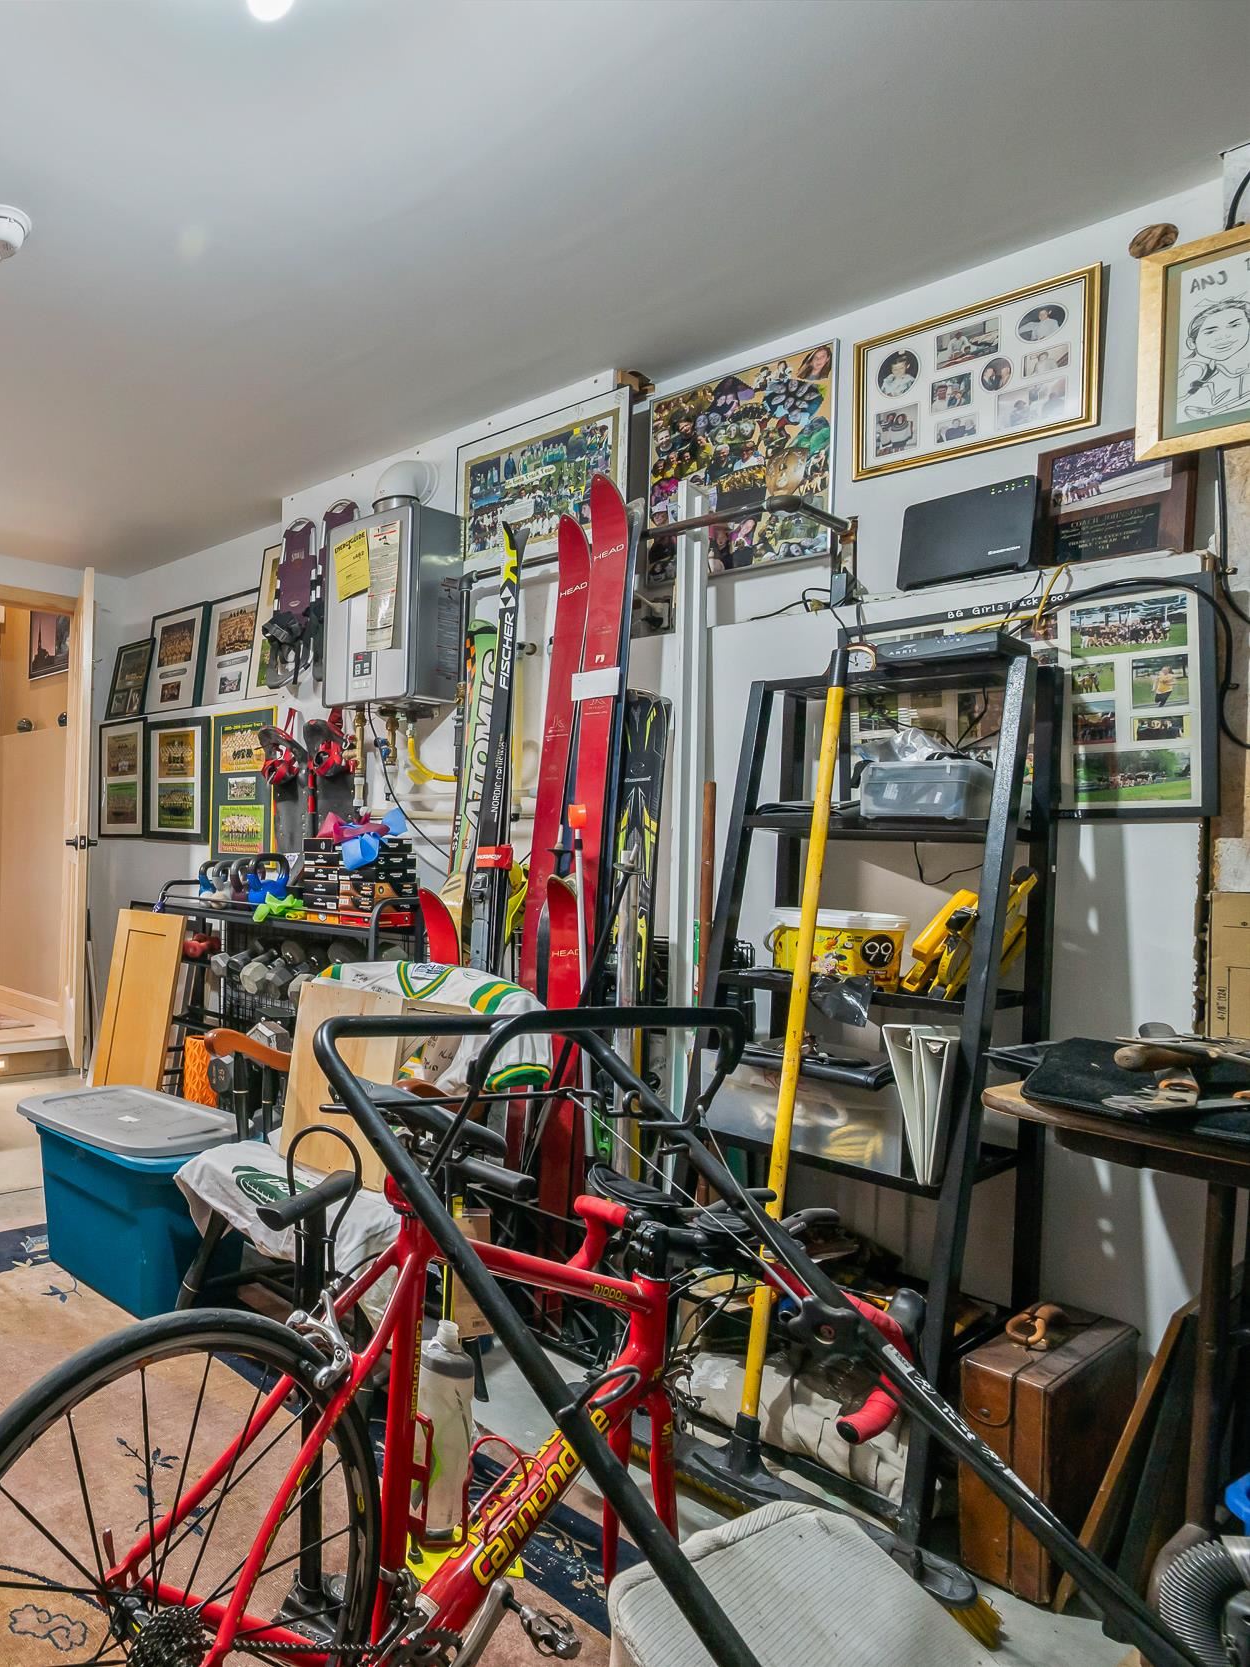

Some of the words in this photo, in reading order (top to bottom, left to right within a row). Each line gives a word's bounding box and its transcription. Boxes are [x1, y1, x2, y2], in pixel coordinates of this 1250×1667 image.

[593, 543, 625, 562] HEAD
[559, 581, 588, 599] HEAD
[947, 611, 964, 619] BG
[971, 604, 1004, 615] Girls
[1007, 597, 1039, 610] Tack
[499, 611, 515, 691] FISCHER
[888, 648, 918, 656] ARRIS
[491, 782, 503, 813] NORDIC
[864, 941, 893, 962] 99
[410, 1319, 423, 1421] cannondale
[472, 1408, 610, 1587] cannonde
